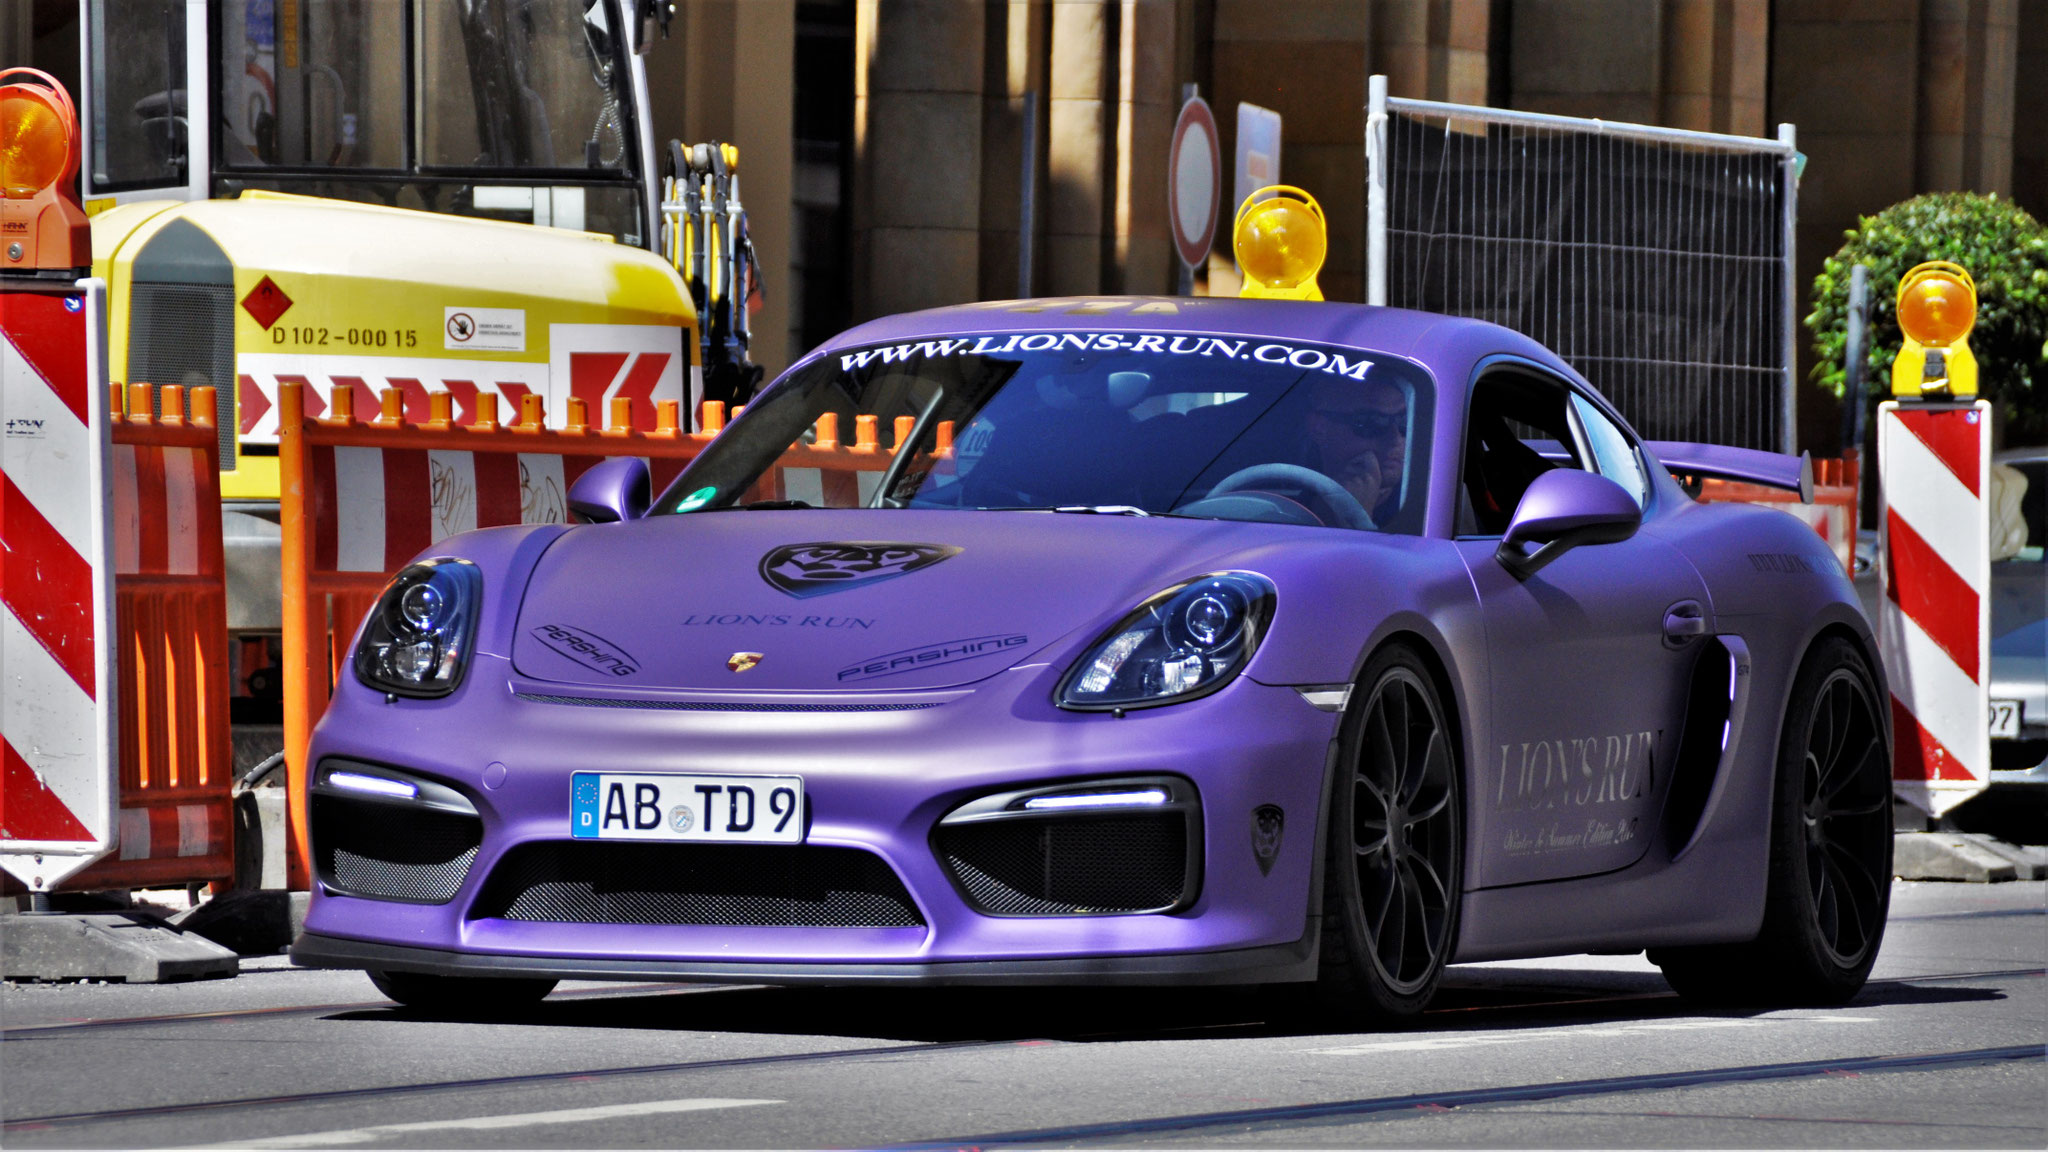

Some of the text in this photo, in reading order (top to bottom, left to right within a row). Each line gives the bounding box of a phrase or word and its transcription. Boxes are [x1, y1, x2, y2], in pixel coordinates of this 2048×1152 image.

[840, 333, 1375, 381] WWW.LIONS-RUN.COM
[680, 614, 877, 630] LION'S RUN
[534, 624, 637, 677] PERSHING
[836, 635, 1028, 681] PERSHING
[1496, 729, 1665, 813] LION'S RUN
[581, 782, 797, 833] D AB TD 9
